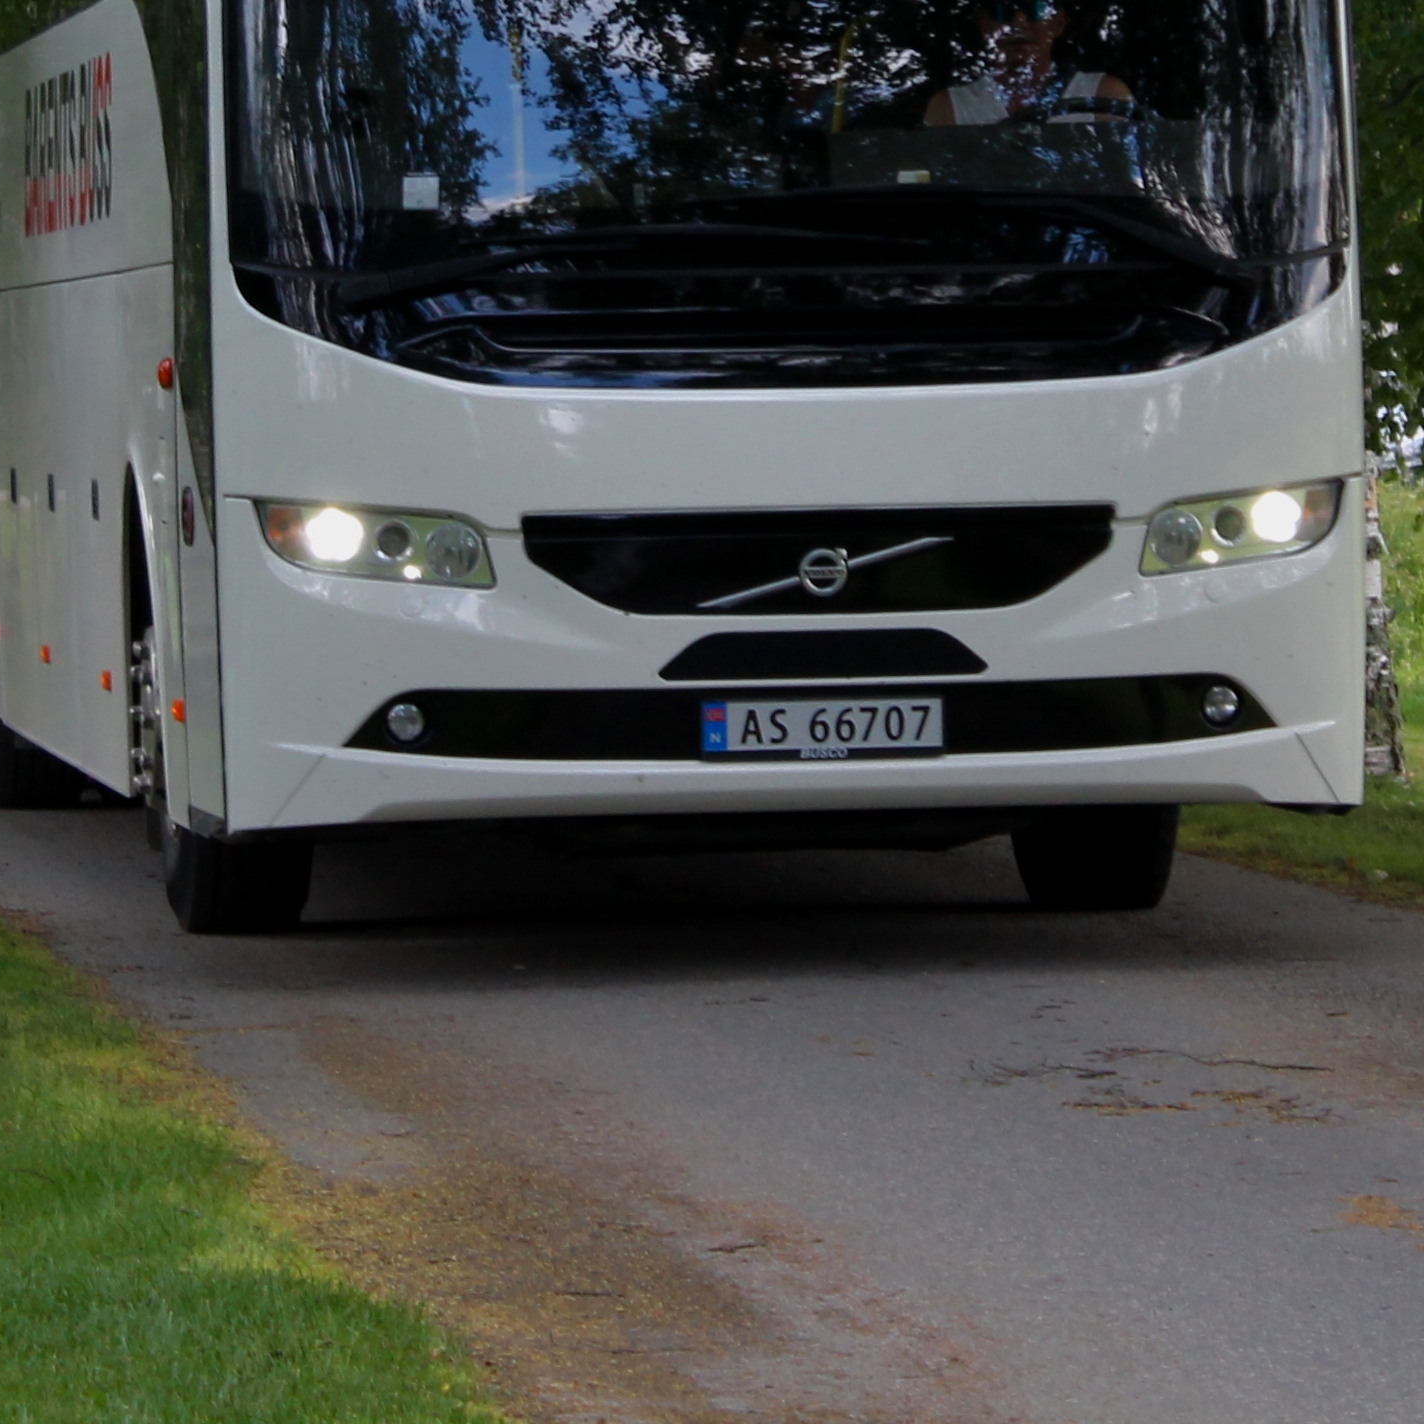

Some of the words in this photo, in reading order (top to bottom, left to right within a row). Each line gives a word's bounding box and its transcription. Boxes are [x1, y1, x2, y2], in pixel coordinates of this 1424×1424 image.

[740, 709, 789, 744] AS
[808, 705, 931, 743] 66707
[709, 732, 722, 744] N
